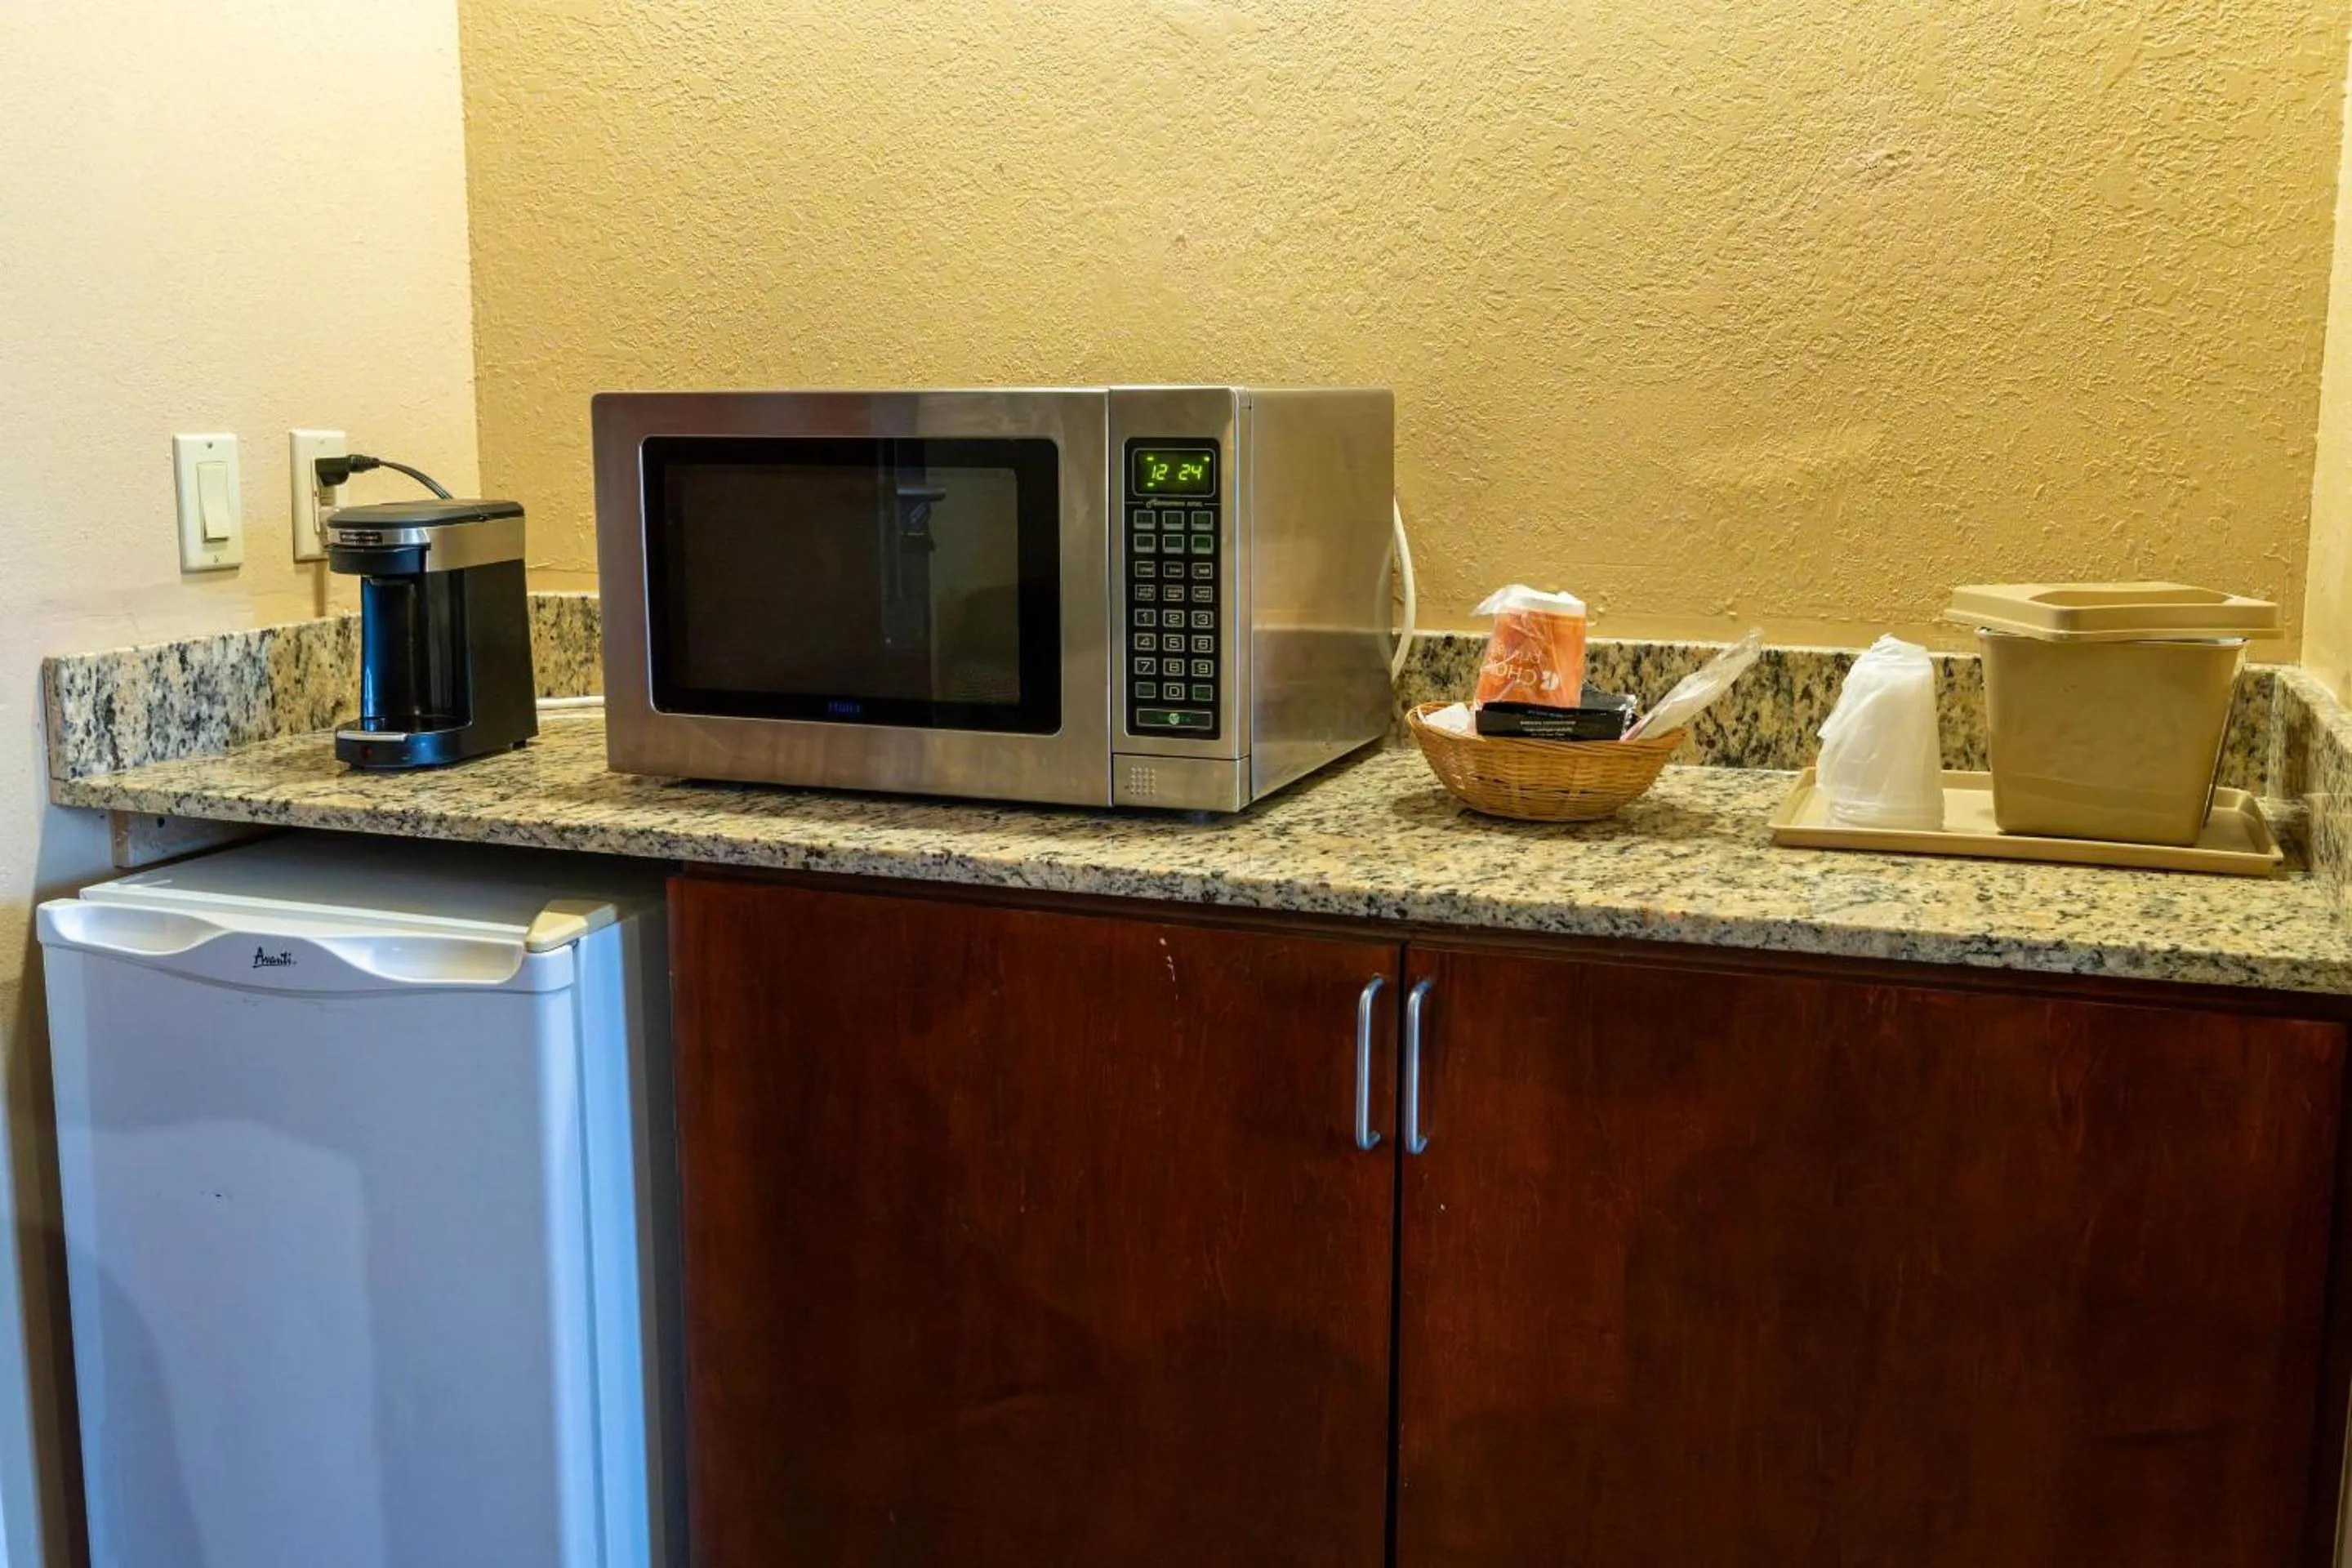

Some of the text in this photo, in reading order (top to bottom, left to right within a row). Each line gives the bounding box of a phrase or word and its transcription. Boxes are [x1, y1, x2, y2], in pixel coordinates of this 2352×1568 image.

[1168, 614, 1180, 623] 2
[1197, 615, 1209, 625] 3
[1169, 639, 1180, 648] 5
[1140, 662, 1209, 674] 7 8 9
[1169, 686, 1180, 697] 0
[252, 946, 292, 969] Avanti
